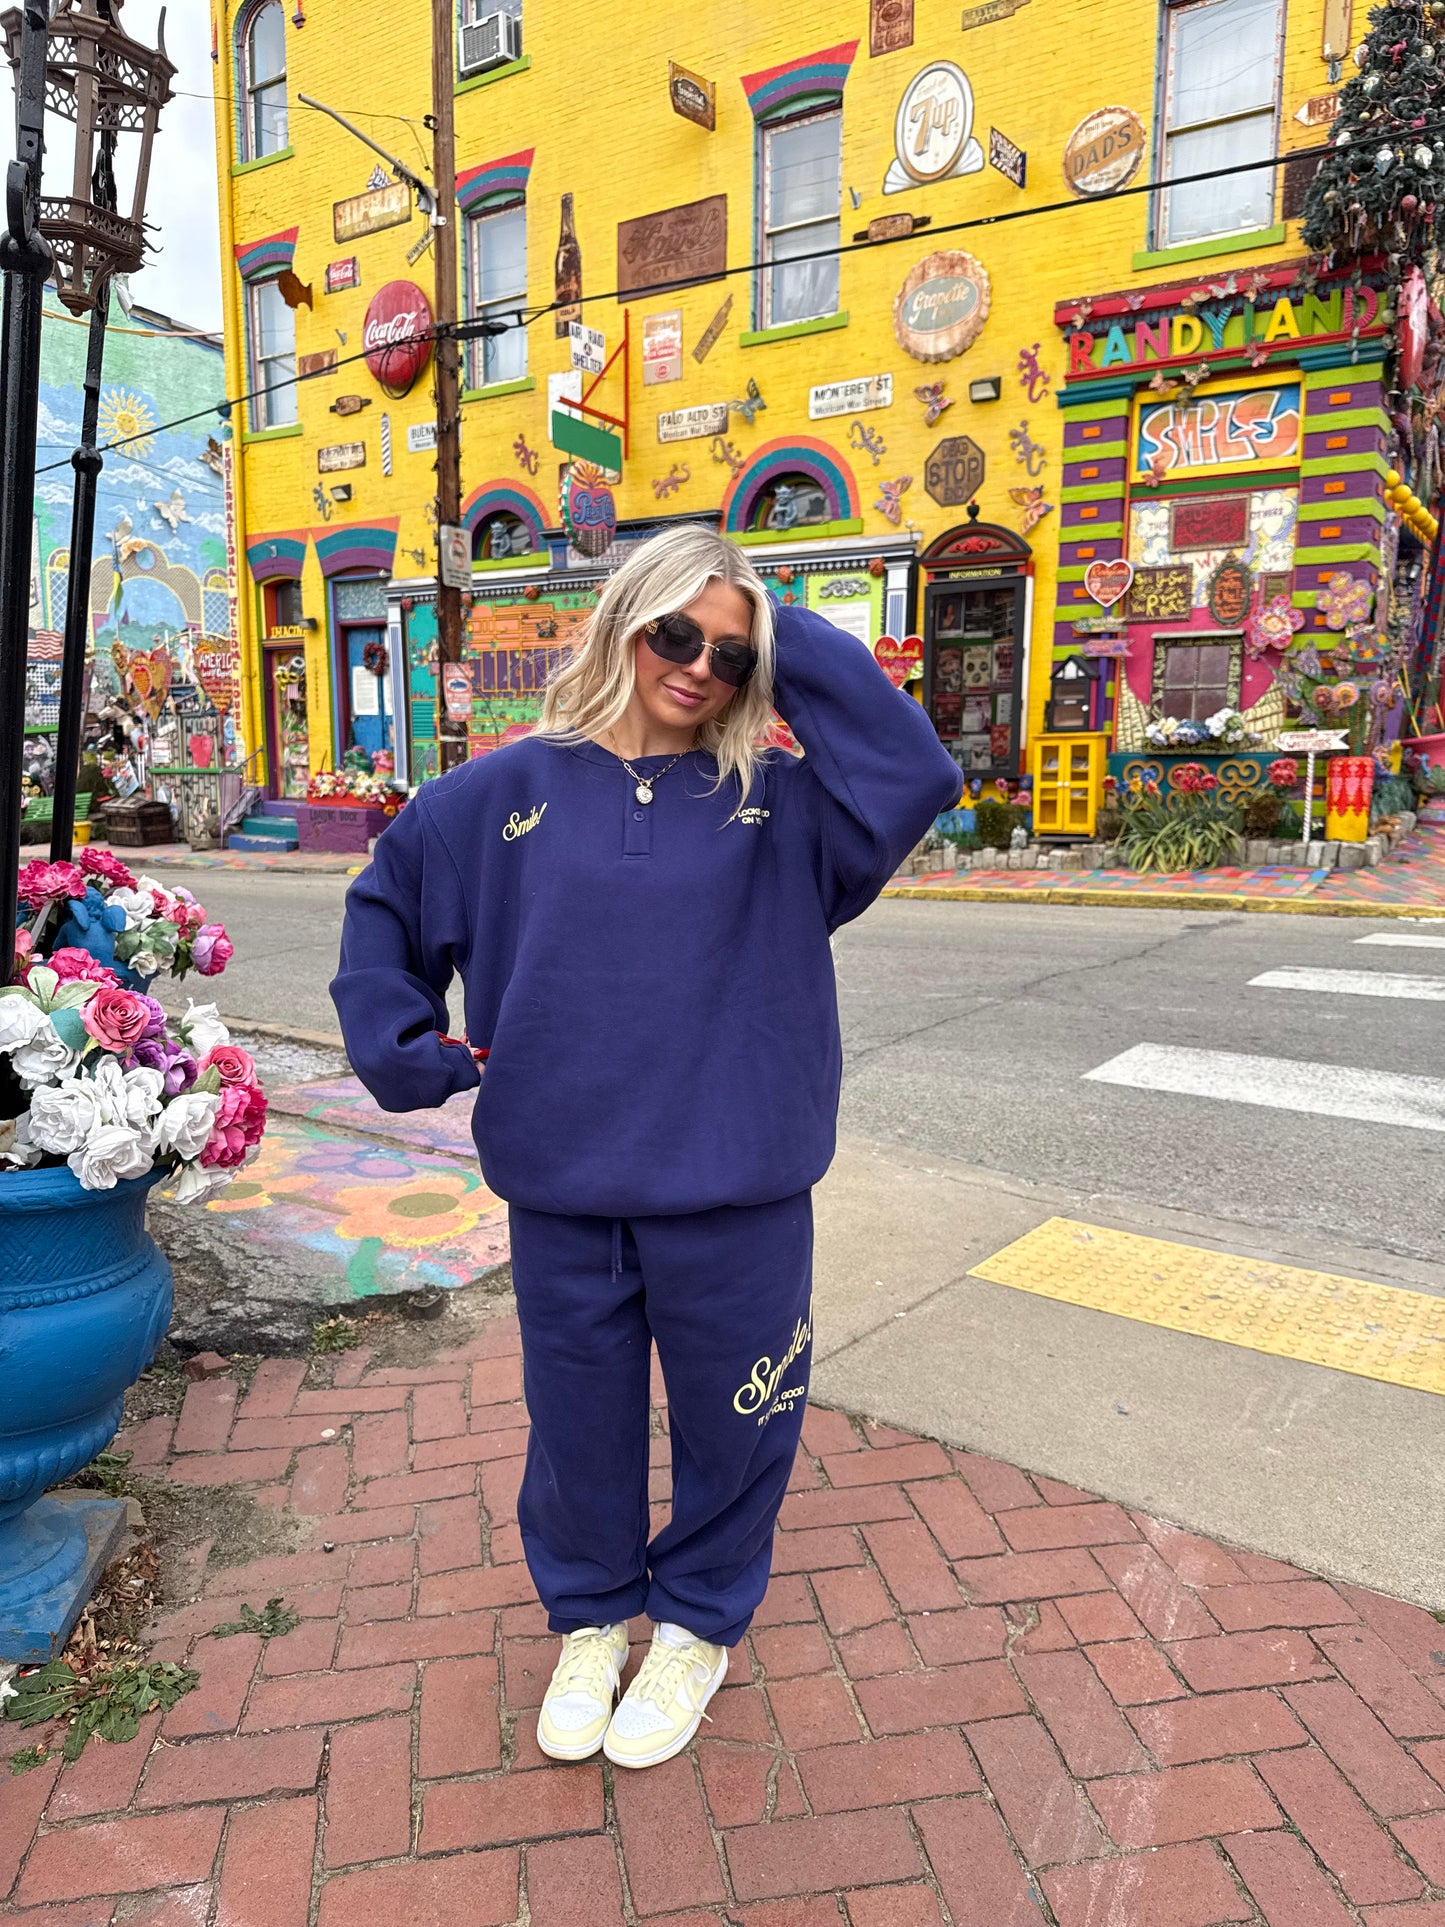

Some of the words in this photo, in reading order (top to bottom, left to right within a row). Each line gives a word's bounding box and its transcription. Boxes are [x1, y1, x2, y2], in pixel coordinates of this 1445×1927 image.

[1308, 95, 1339, 119] WEST
[1073, 123, 1132, 177] DAD'S
[571, 323, 583, 341] AIR
[588, 330, 604, 348] RAID
[1069, 285, 1379, 374] RANDYLAND
[573, 352, 603, 374] SHELTER
[814, 380, 873, 401] MONTEREY
[661, 413, 684, 427] PALO
[687, 409, 709, 422] ALTO
[711, 406, 724, 419] ST
[928, 456, 980, 488] STOP
[223, 446, 237, 589] INTERNATIONAL
[949, 567, 1002, 579] INFORMATION
[228, 597, 241, 671] WELCOME
[502, 801, 548, 842] Smile!
[741, 817, 755, 825] ON
[733, 1293, 814, 1415] Smile!
[780, 1385, 805, 1400] GOOD
